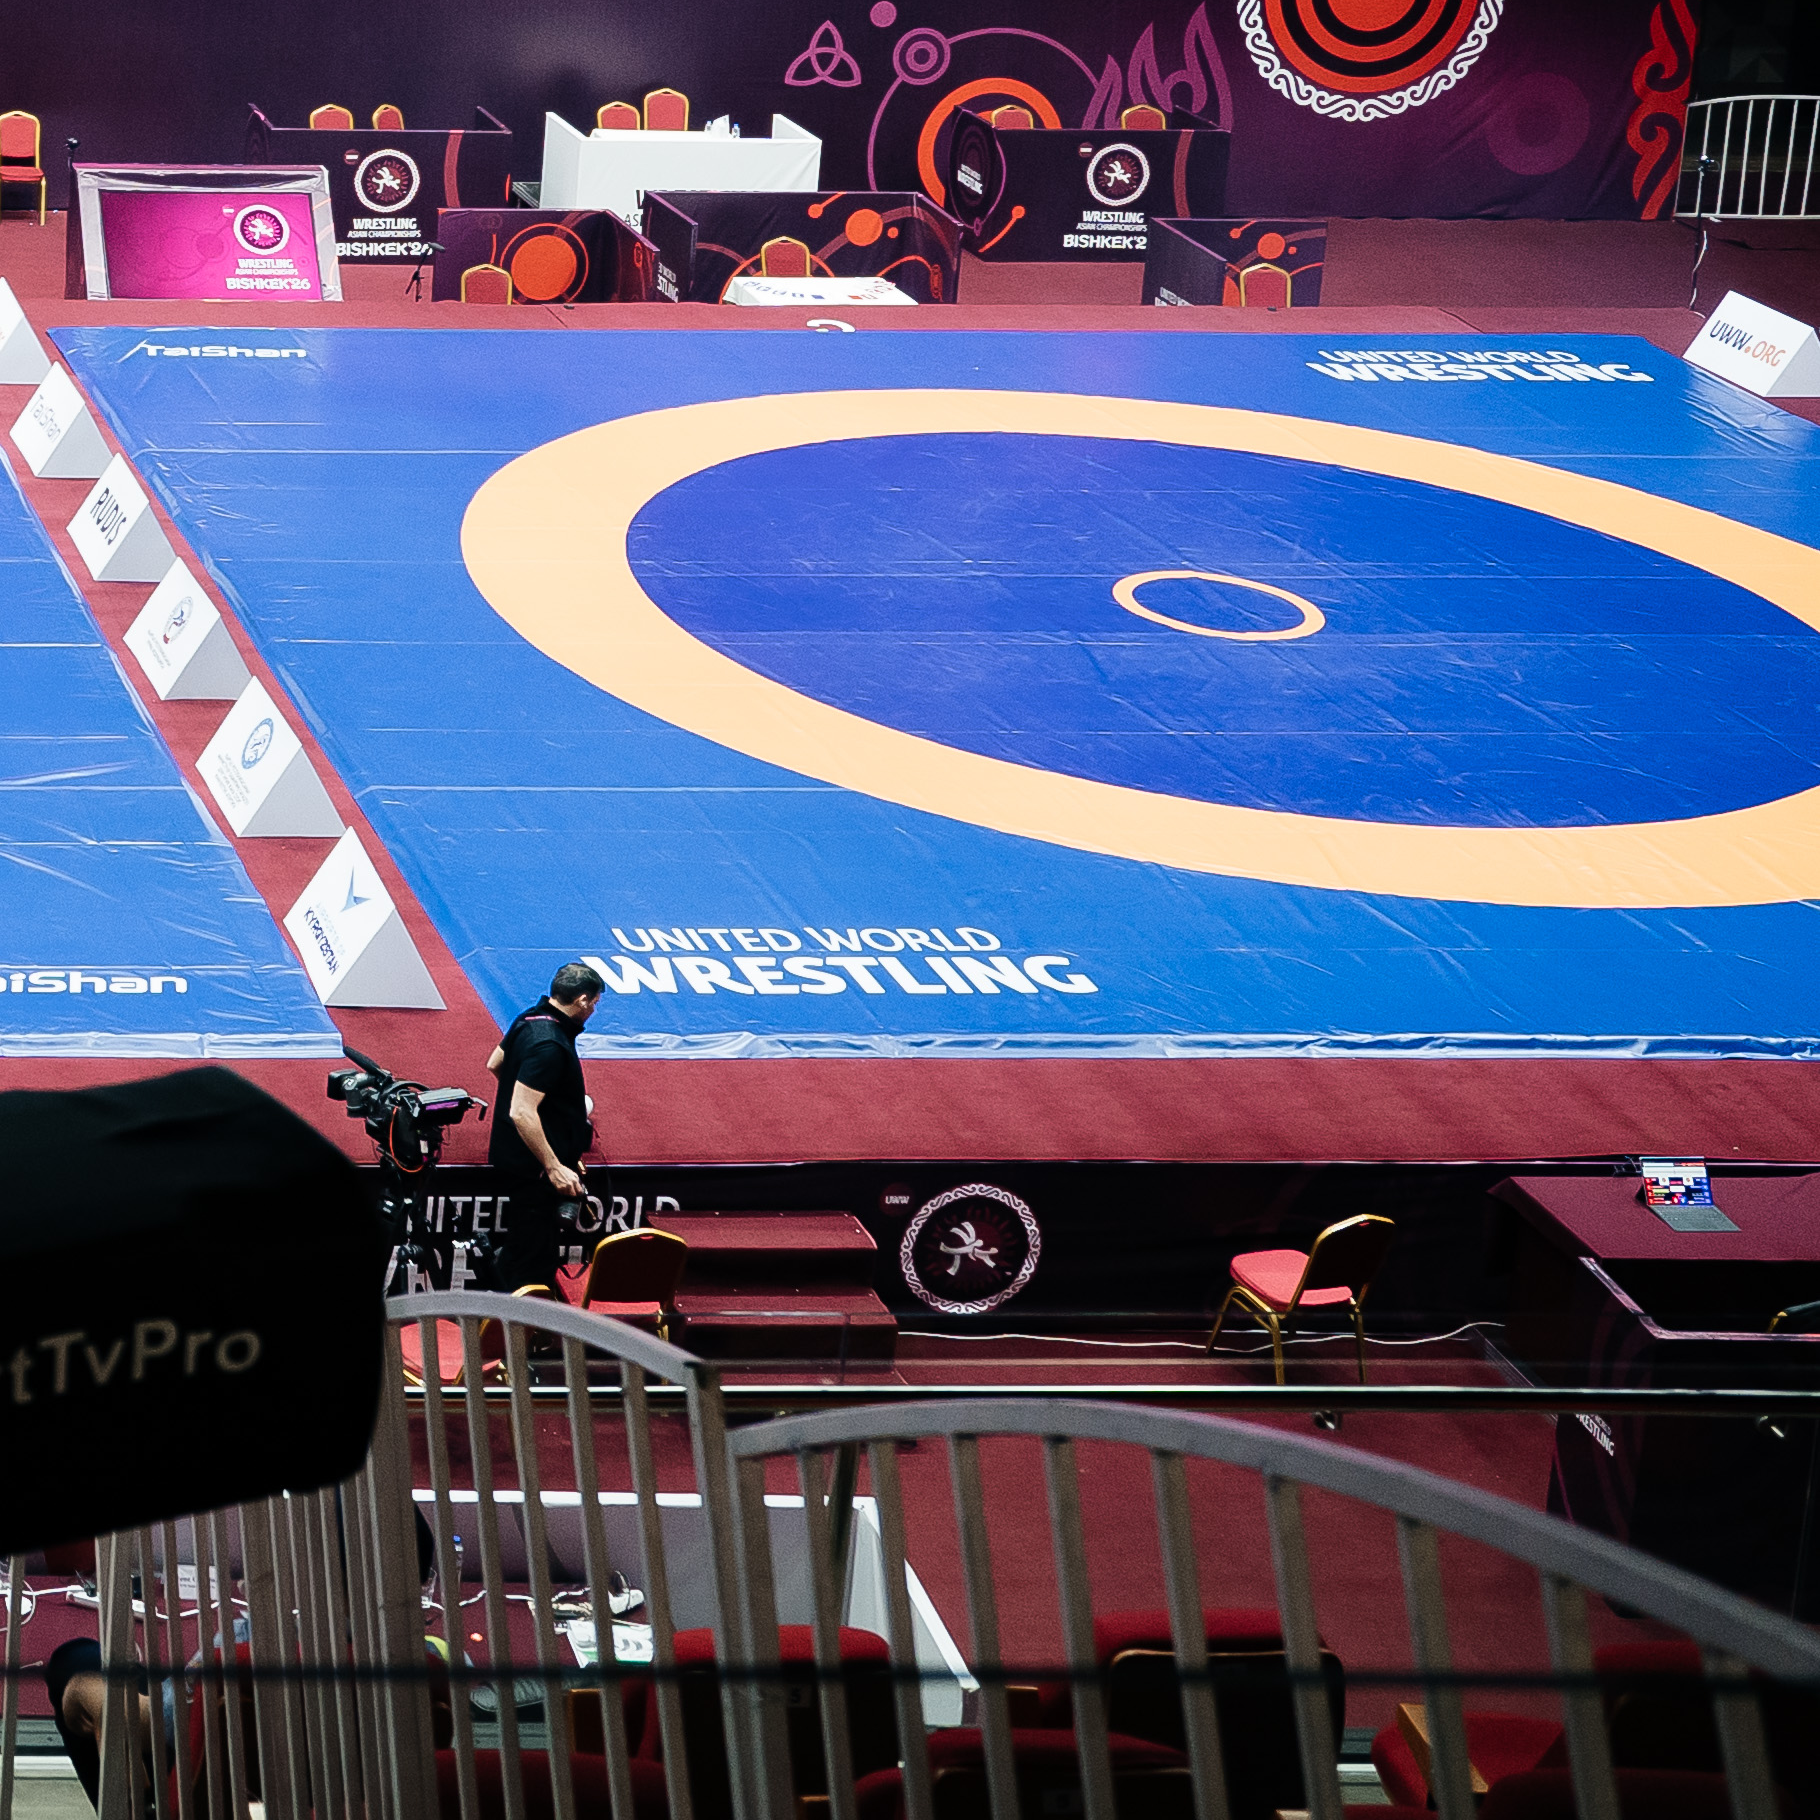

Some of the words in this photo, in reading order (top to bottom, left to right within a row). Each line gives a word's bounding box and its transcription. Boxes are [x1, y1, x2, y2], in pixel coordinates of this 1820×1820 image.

[353, 218, 418, 230] WRESTLING
[1082, 210, 1145, 223] WRESTLING
[1063, 234, 1147, 249] BISHKEK'2
[237, 258, 295, 269] WRESTLING
[226, 277, 311, 290] BISHKEK'26
[146, 346, 308, 358] TaiShan
[1709, 319, 1787, 368] UWW.ORG
[1319, 349, 1434, 366] UNITED
[1440, 350, 1581, 366] WORLD
[1305, 362, 1655, 384] WRESTLING
[30, 394, 62, 443] TaiShan
[90, 487, 127, 546] RUDIS
[613, 926, 800, 954] UNITED
[808, 926, 1003, 955] WORLD
[588, 955, 1101, 996] WRESTLING
[1576, 1414, 1615, 1457] RESTLING
